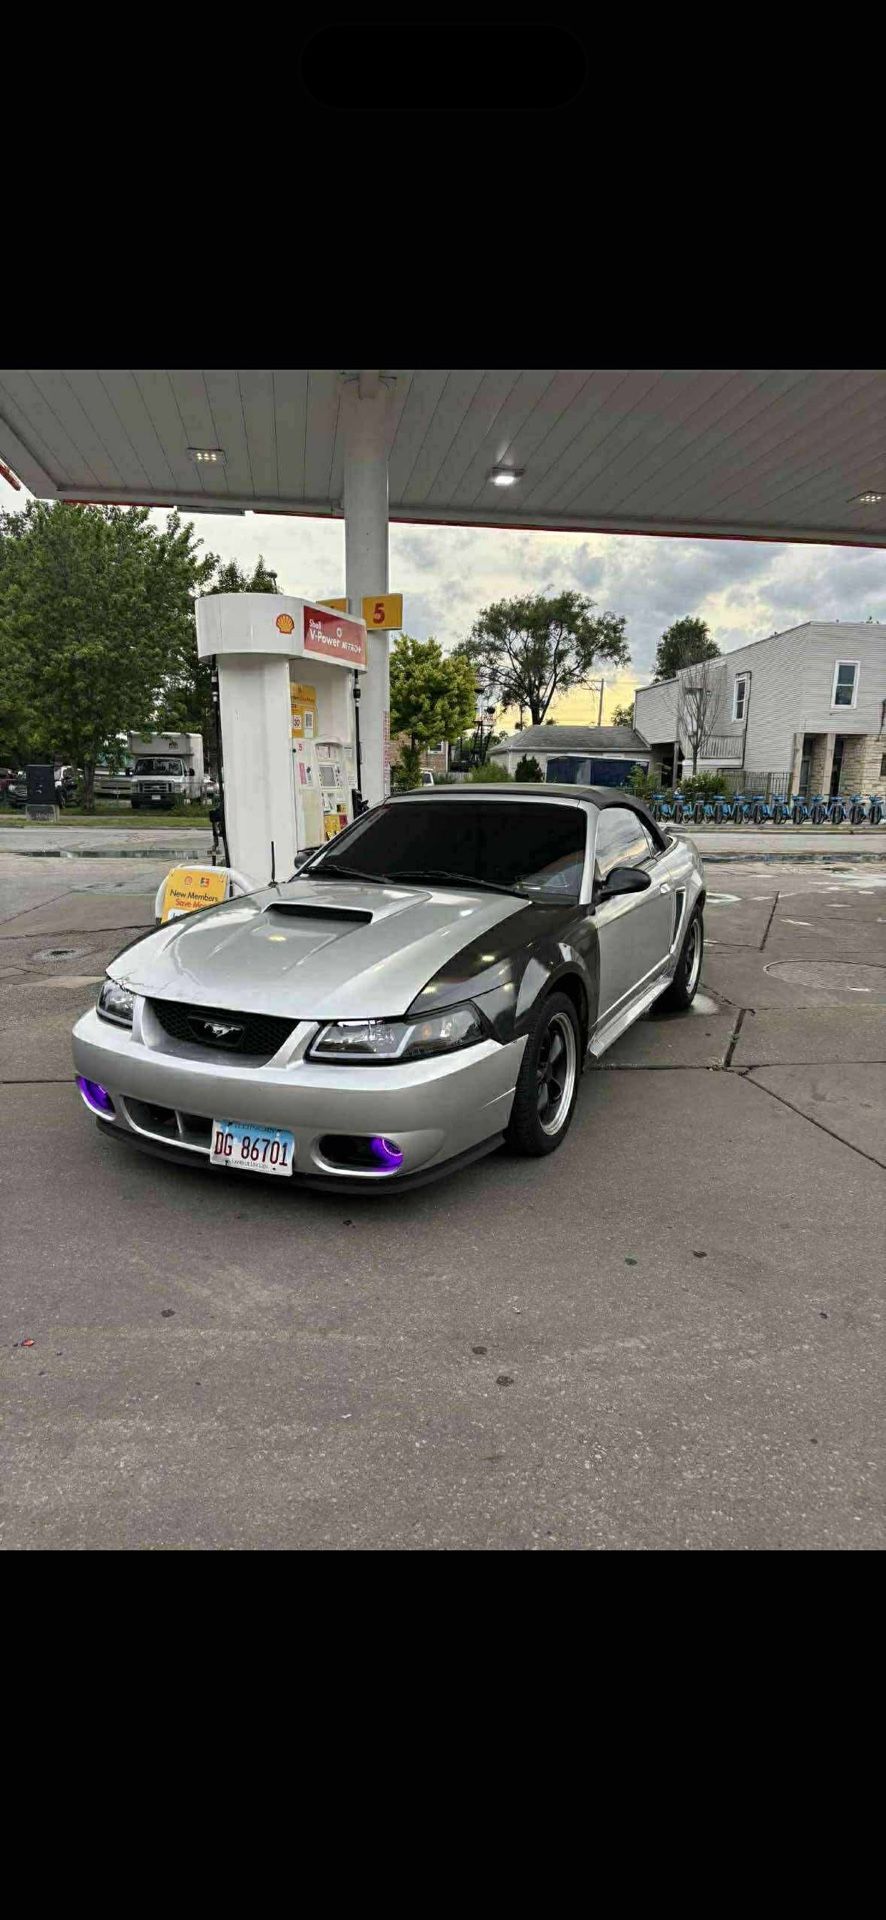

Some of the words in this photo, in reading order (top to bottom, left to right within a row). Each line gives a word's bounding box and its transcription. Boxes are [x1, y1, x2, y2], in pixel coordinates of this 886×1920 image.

[373, 602, 385, 625] 5
[309, 618, 322, 630] Shell
[309, 628, 340, 648] V-Power
[170, 889, 186, 898] New
[188, 892, 218, 902] Members
[175, 899, 192, 908] Save
[214, 1131, 233, 1157] DG
[241, 1135, 288, 1167] 86701
